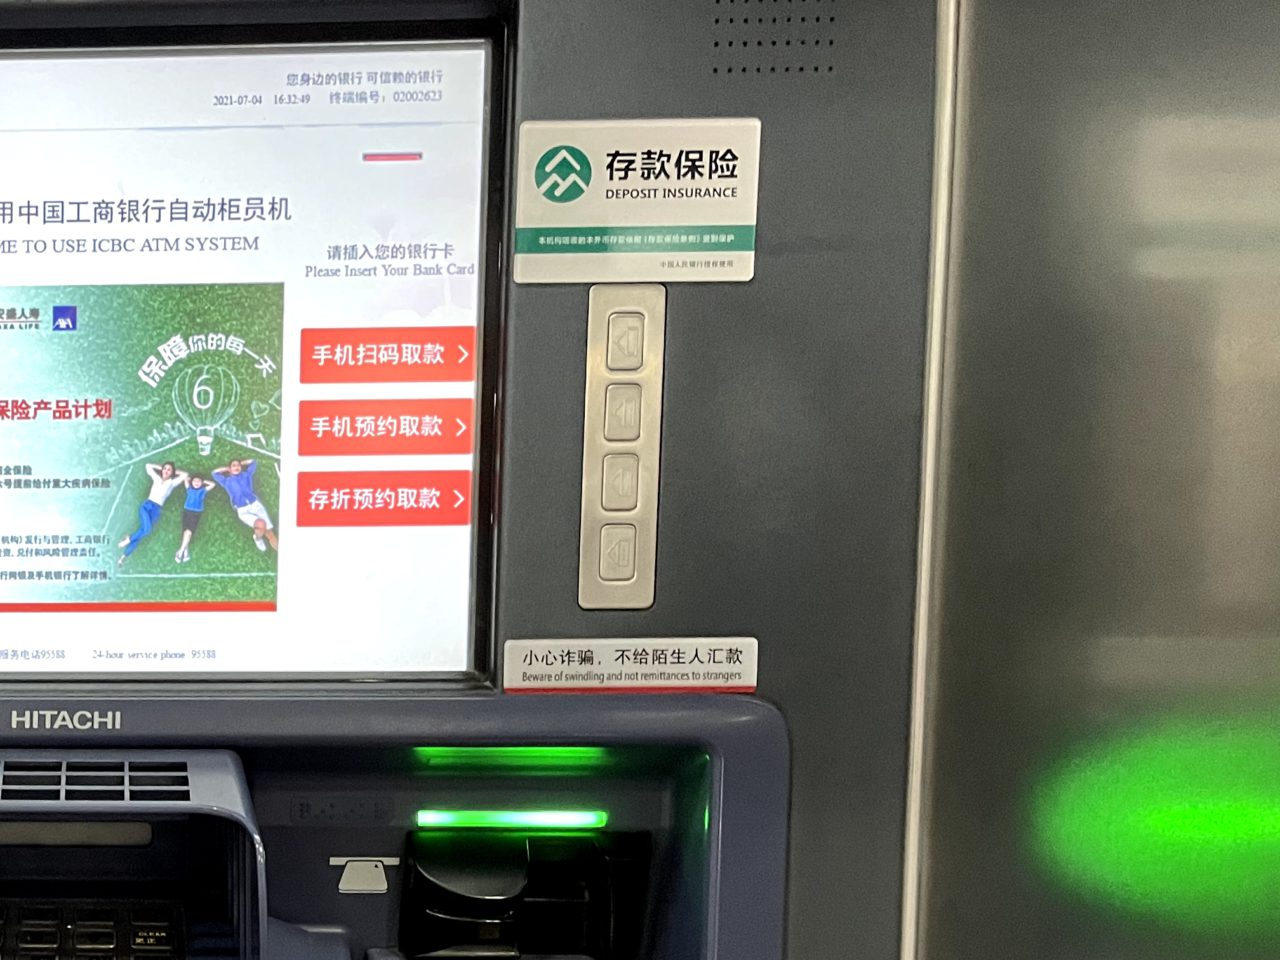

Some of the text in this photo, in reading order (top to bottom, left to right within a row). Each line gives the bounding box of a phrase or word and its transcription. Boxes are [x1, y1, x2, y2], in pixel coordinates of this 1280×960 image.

[286, 69, 444, 86] 您身边的银行 可信赖的银行
[213, 94, 263, 106] 2021-07-04
[273, 93, 311, 105] 16:32:49
[606, 148, 739, 181] 存款保险
[606, 187, 738, 199] DEPOSIT INSURANCE
[22, 239, 48, 254] TO
[53, 239, 87, 254] USE
[92, 238, 135, 253] ICBC
[140, 237, 180, 252] ATM
[185, 236, 260, 252] SYSTEM
[327, 243, 455, 261] 请插入您的银行卡
[305, 262, 476, 278] Please Insert Your Bank Card
[137, 332, 277, 389] 保障你的每一天
[312, 343, 446, 366] 手机扫码取款
[192, 374, 214, 410] 6
[310, 415, 443, 438] 手机预约取款
[308, 487, 441, 510] 存折预约取款
[522, 670, 742, 684] Beware of swindling and not remittances to strangers
[11, 710, 121, 730] HITACHI
